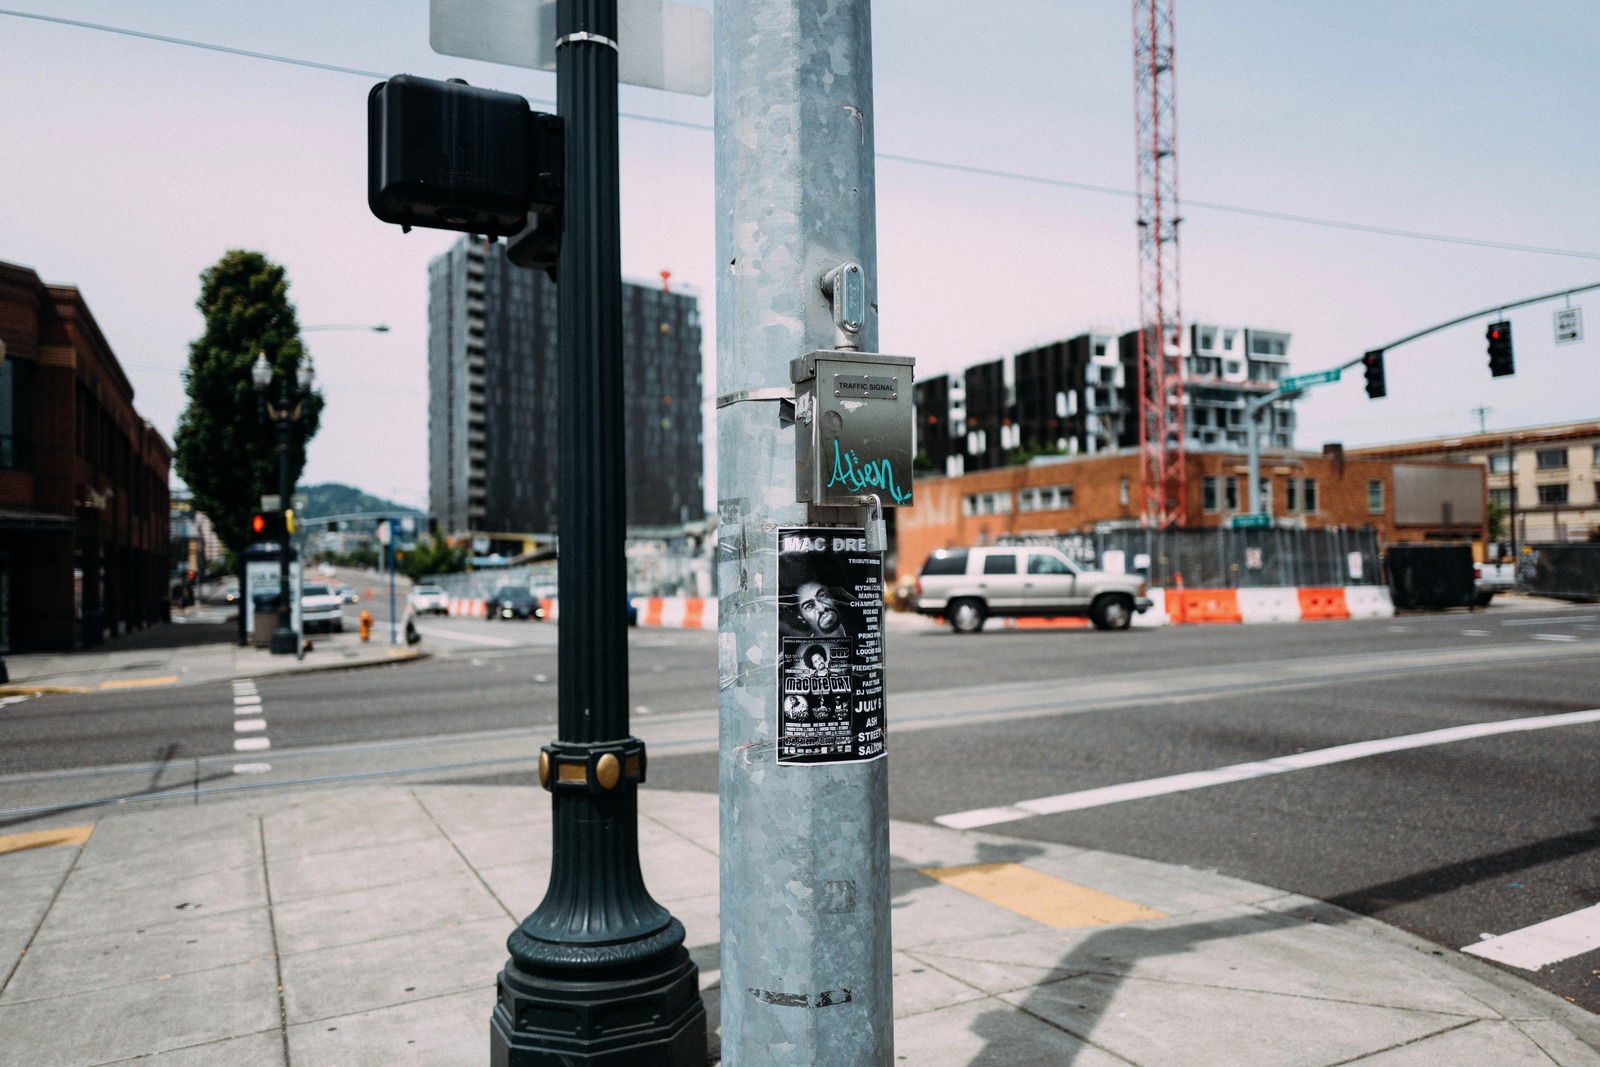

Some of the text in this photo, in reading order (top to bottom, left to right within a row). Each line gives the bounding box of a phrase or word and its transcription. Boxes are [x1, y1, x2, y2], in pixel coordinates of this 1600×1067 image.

[839, 382, 894, 392] TRAFFIC SIGNAL
[784, 537, 867, 552] MAC DRE
[855, 699, 877, 713] JULY
[865, 716, 877, 728] ASH
[858, 728, 881, 742] STREET
